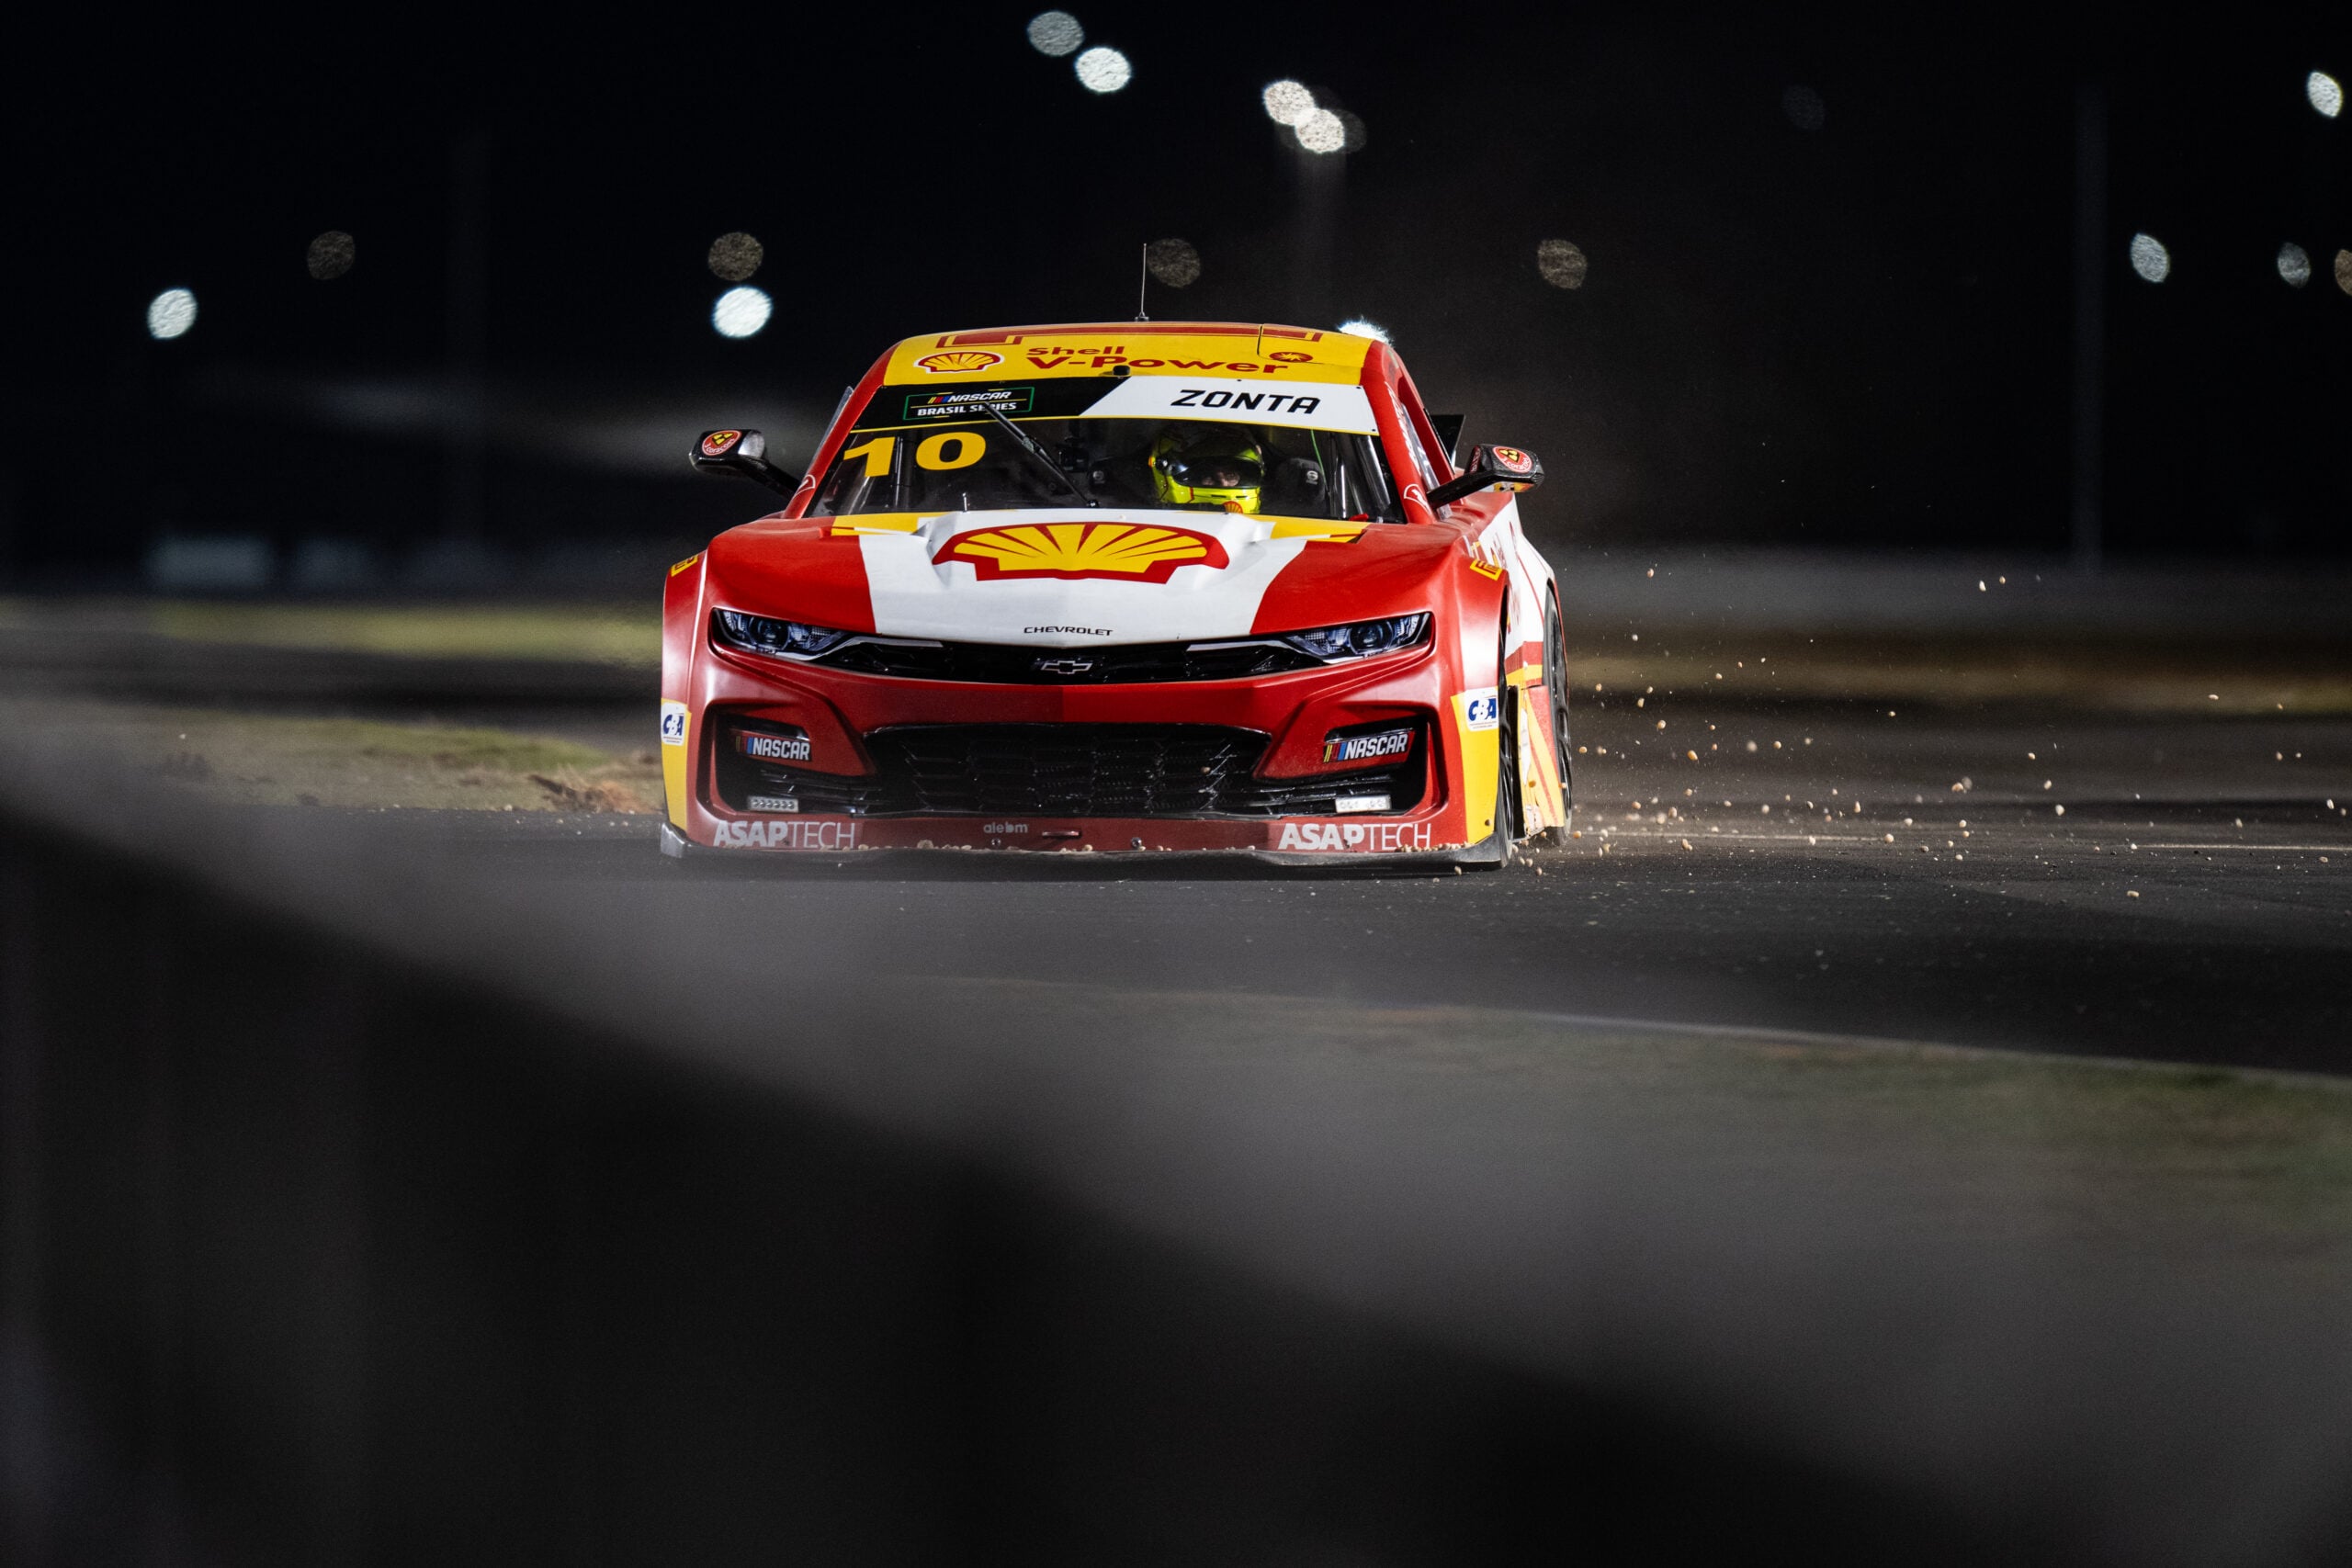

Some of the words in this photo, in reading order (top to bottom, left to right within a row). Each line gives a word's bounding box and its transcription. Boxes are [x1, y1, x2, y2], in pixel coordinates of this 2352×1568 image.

[1027, 346, 1125, 355] Shell
[1026, 355, 1288, 374] V-Power
[947, 391, 1012, 403] NASCAR
[1170, 389, 1321, 414] ZONTA
[917, 406, 966, 417] BRASIL
[843, 432, 986, 478] 10
[1023, 626, 1114, 637] CHEVROLET
[1468, 698, 1497, 721] CBA
[662, 714, 684, 736] CBA
[752, 737, 811, 761] NASCAR
[1344, 734, 1408, 761] NASCAR
